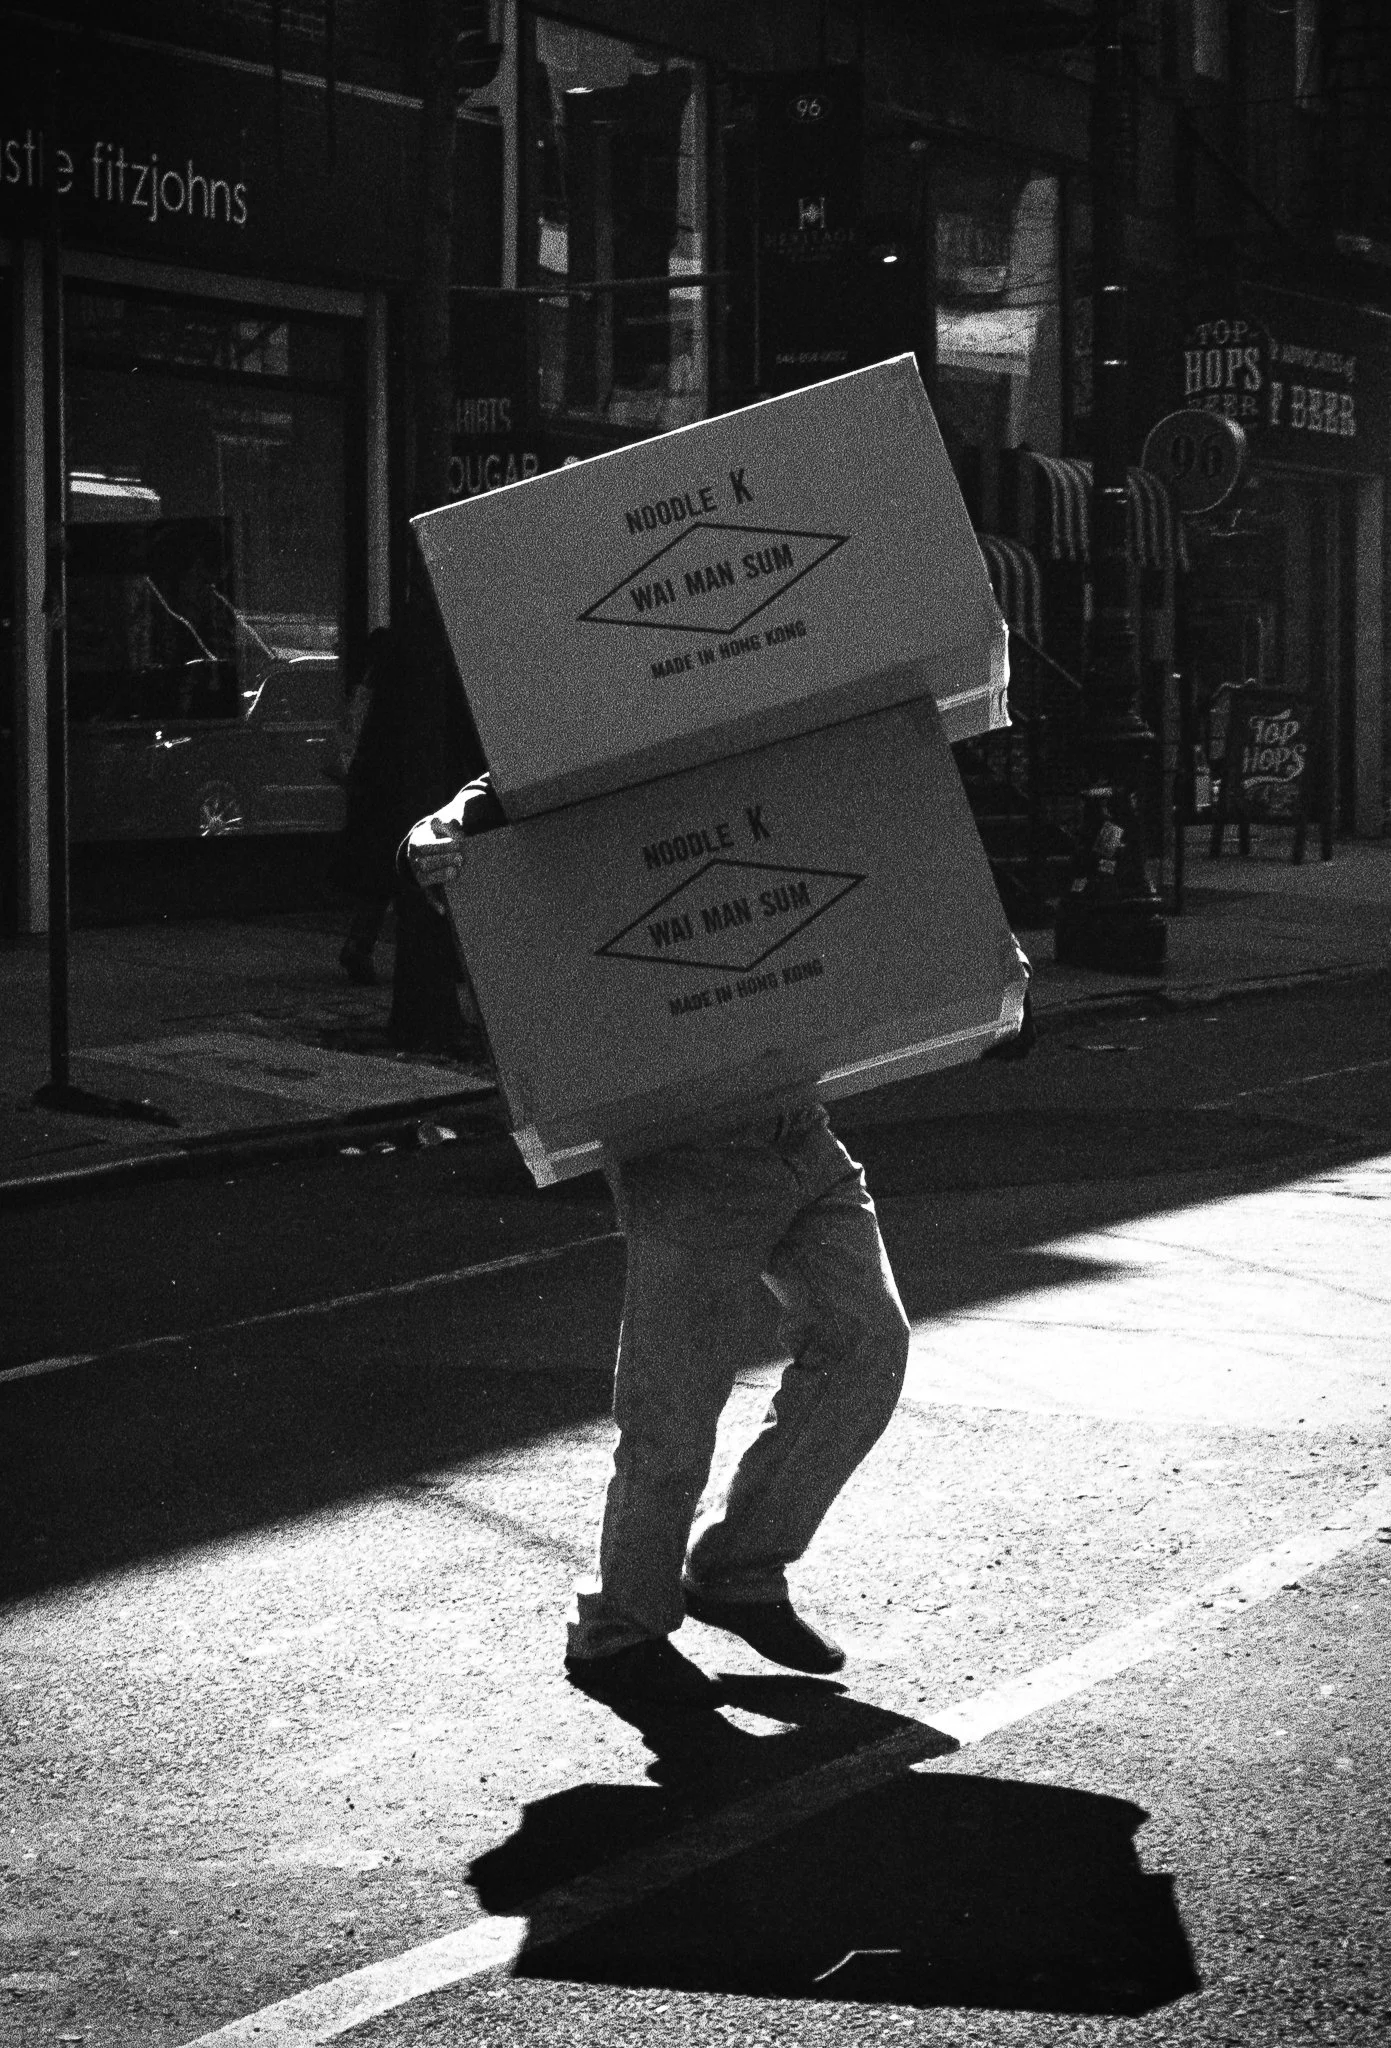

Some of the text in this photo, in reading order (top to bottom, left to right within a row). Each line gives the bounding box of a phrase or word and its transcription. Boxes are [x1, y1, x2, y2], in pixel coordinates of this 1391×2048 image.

[796, 98, 823, 118] 96
[0, 129, 249, 226] stle fitzjohns
[1196, 318, 1250, 346] TOP
[1183, 346, 1263, 396] HOPS
[454, 396, 513, 433] HIRTS
[1290, 383, 1358, 437] BEER
[449, 452, 540, 495] OUGAR
[1169, 433, 1224, 483] 96
[625, 468, 754, 534] NOODLE K
[630, 543, 794, 612] WAI MAN SUM
[650, 620, 807, 679] MADE IN HONG KONG
[1241, 742, 1308, 784] HOPS
[641, 804, 771, 870] NOODLE K
[647, 881, 811, 949] WAI MAN SUM
[669, 959, 824, 1017] MADE IN HONG KONG
